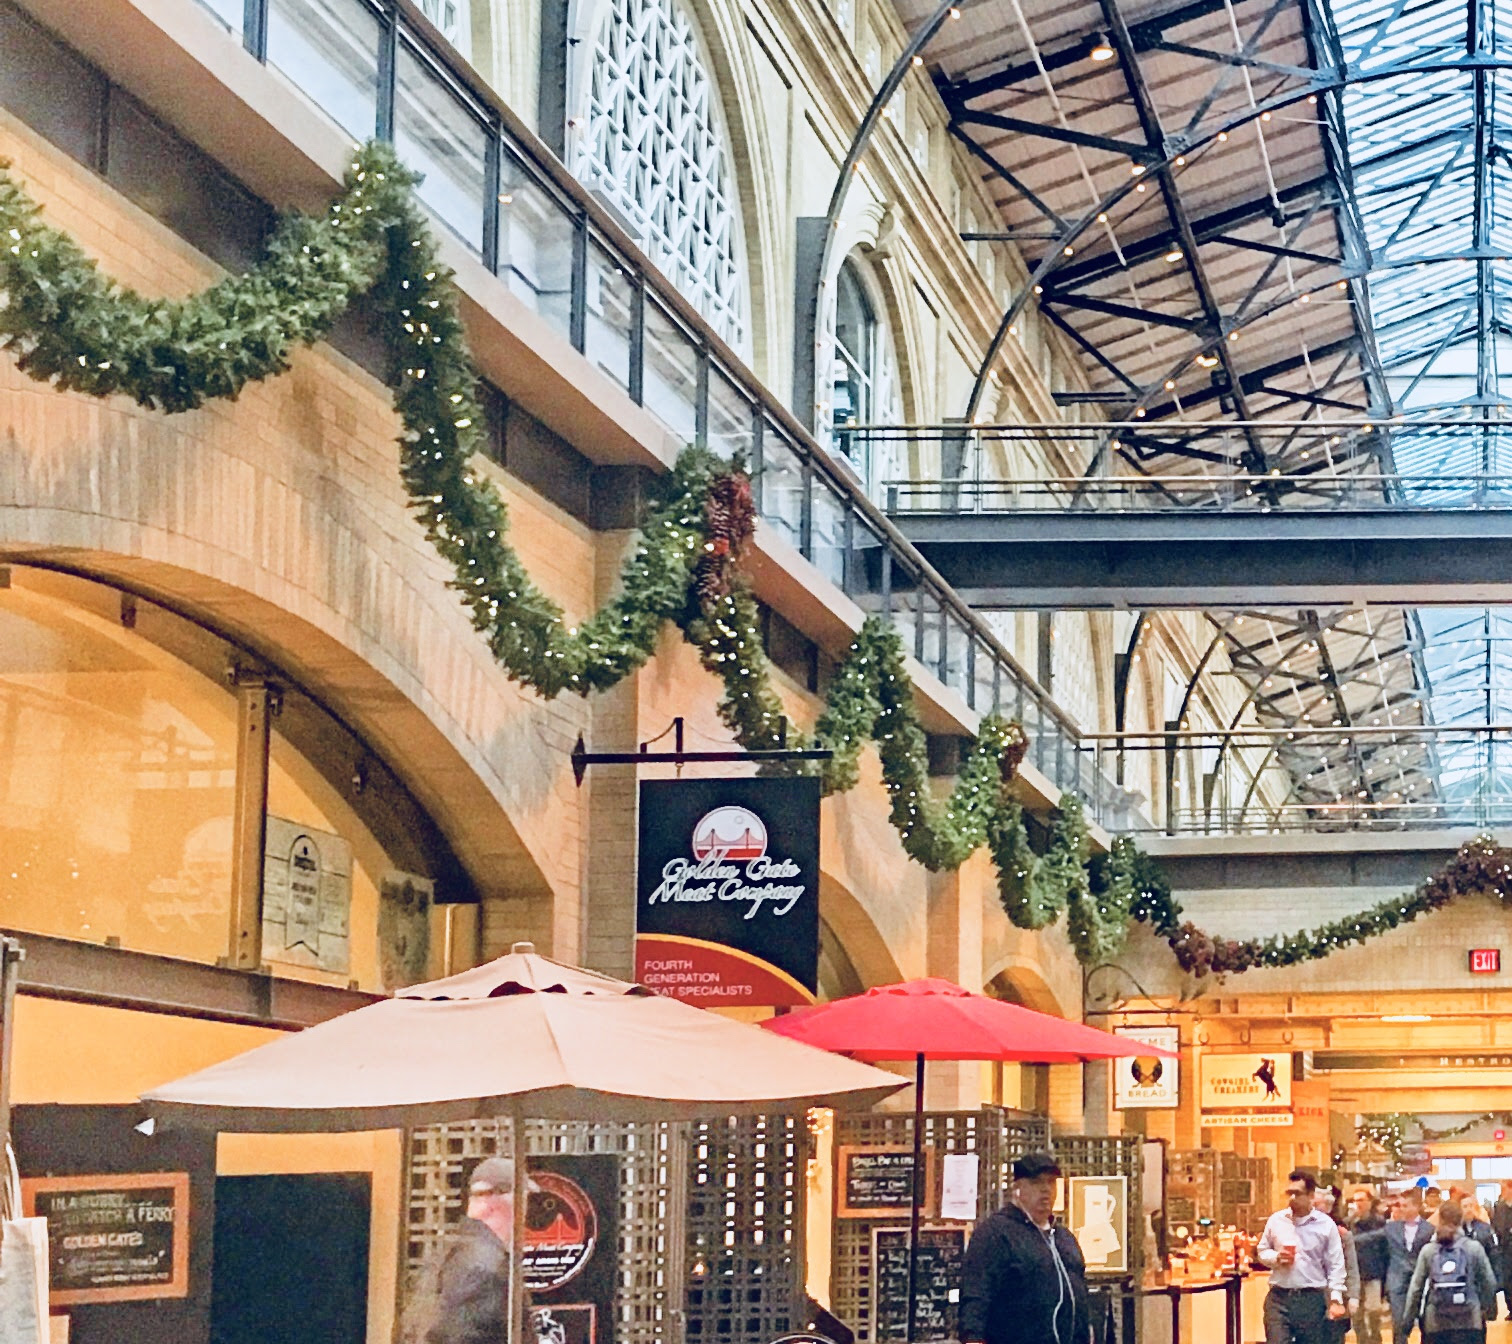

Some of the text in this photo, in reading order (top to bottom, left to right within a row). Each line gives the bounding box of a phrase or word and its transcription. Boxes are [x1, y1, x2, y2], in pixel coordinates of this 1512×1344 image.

[662, 848, 801, 882] Golden Gate
[648, 878, 806, 920] Meat Company
[644, 960, 693, 971] FOURTH
[1473, 951, 1496, 971] EXIT
[643, 972, 720, 984] GENERATION
[647, 985, 753, 997] EAT SPECIALISTS
[1210, 1077, 1249, 1085] COWGIRL
[1128, 1090, 1166, 1098] BREAD
[1214, 1086, 1259, 1094] CREAMERY
[1250, 1116, 1289, 1124] CHEESE
